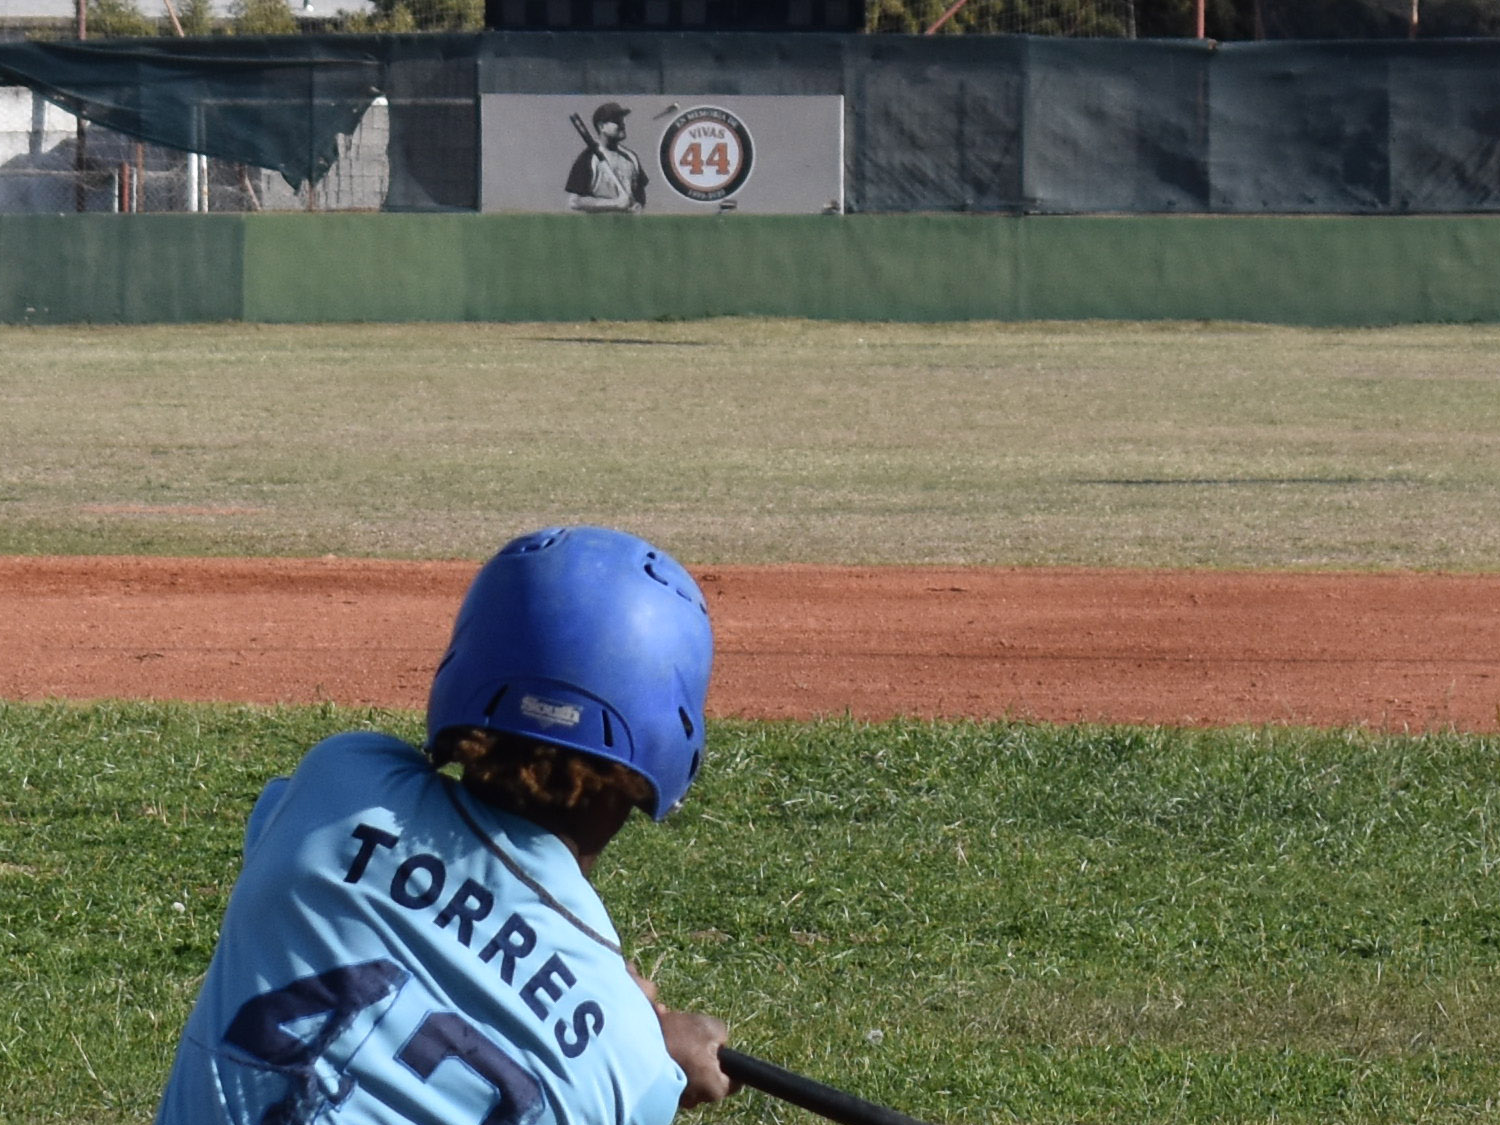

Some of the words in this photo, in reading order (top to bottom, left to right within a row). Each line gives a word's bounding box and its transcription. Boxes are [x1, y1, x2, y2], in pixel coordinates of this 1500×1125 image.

[689, 126, 726, 140] VIVAS
[679, 142, 731, 175] 44
[343, 822, 605, 1059] TORRES
